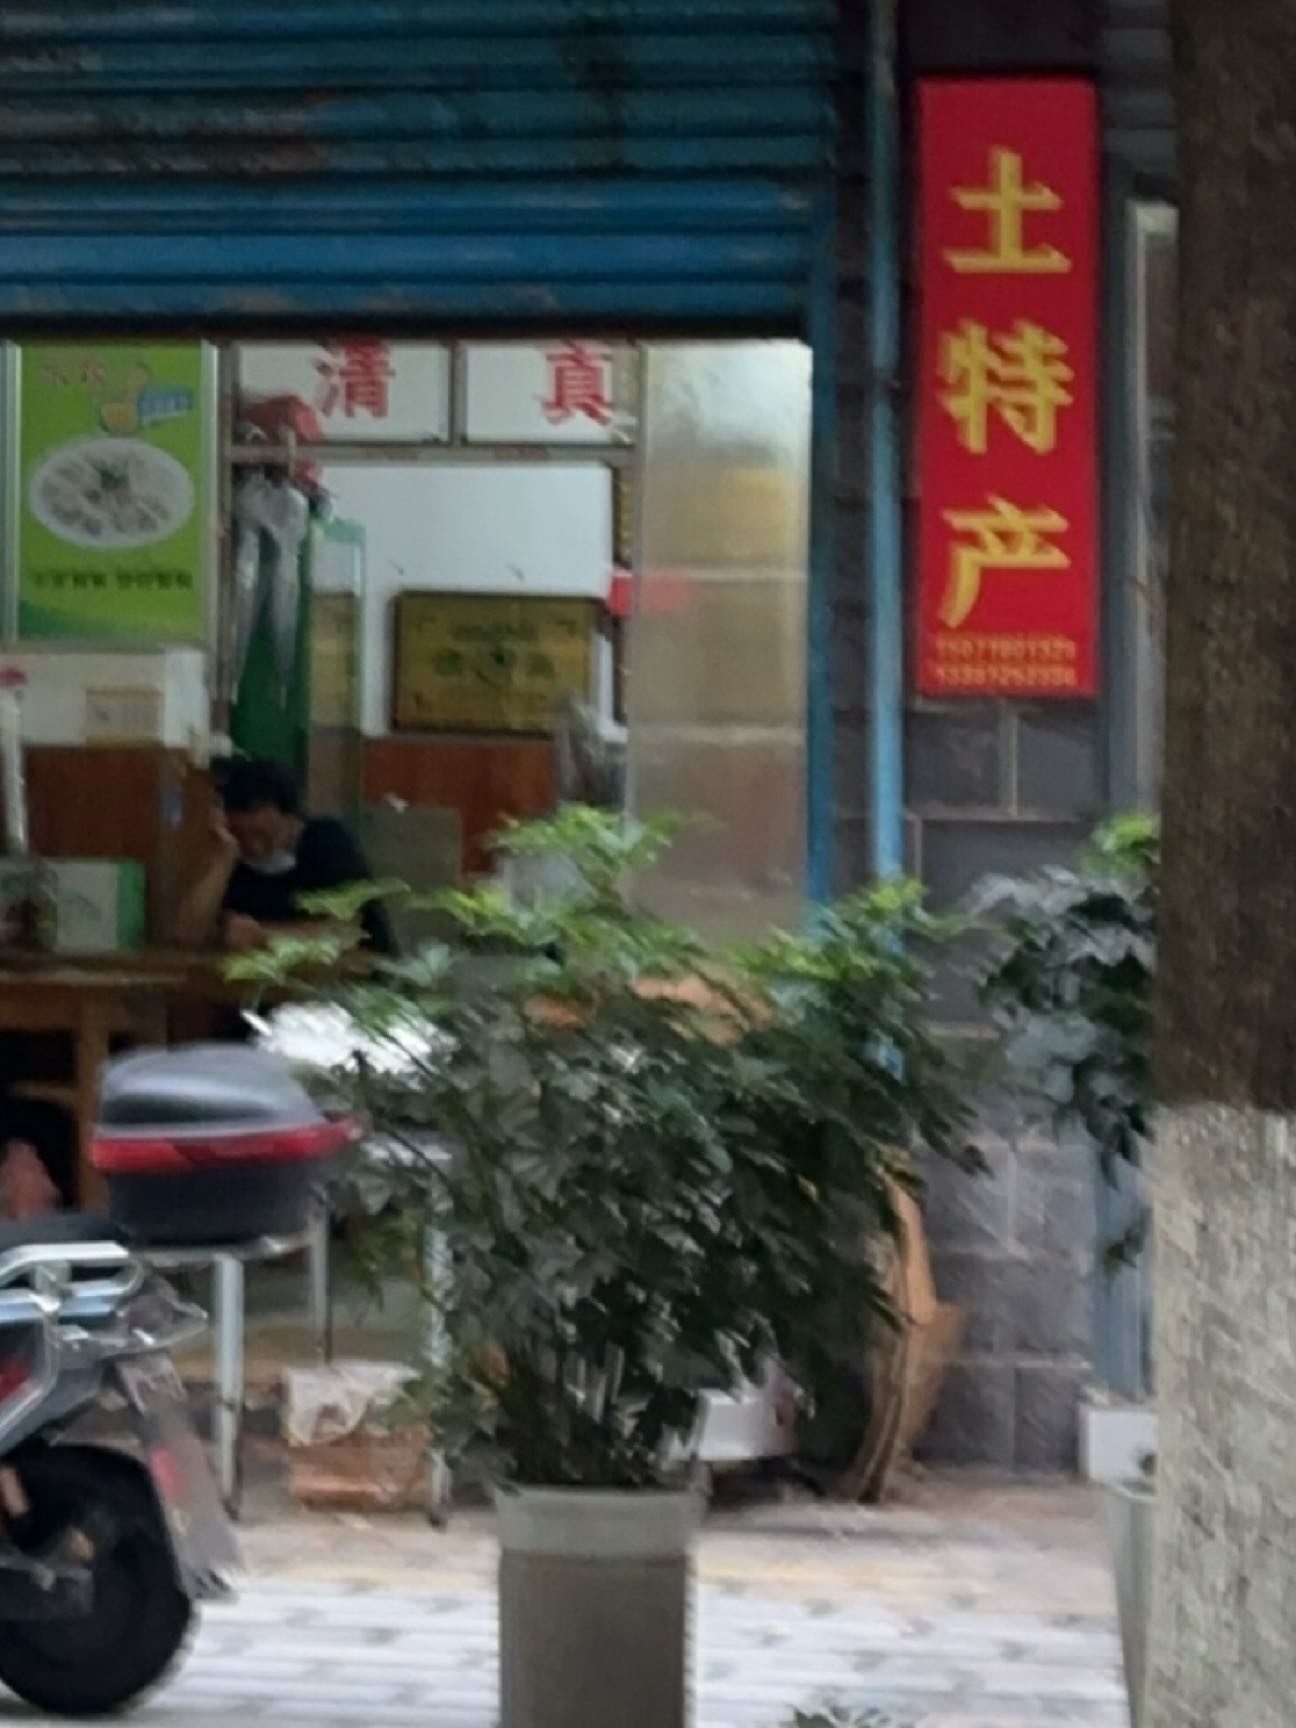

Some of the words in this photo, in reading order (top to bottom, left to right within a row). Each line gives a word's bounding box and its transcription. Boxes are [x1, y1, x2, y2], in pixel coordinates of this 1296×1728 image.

[314, 338, 615, 425] 清真
[935, 144, 1075, 630] 土特产
